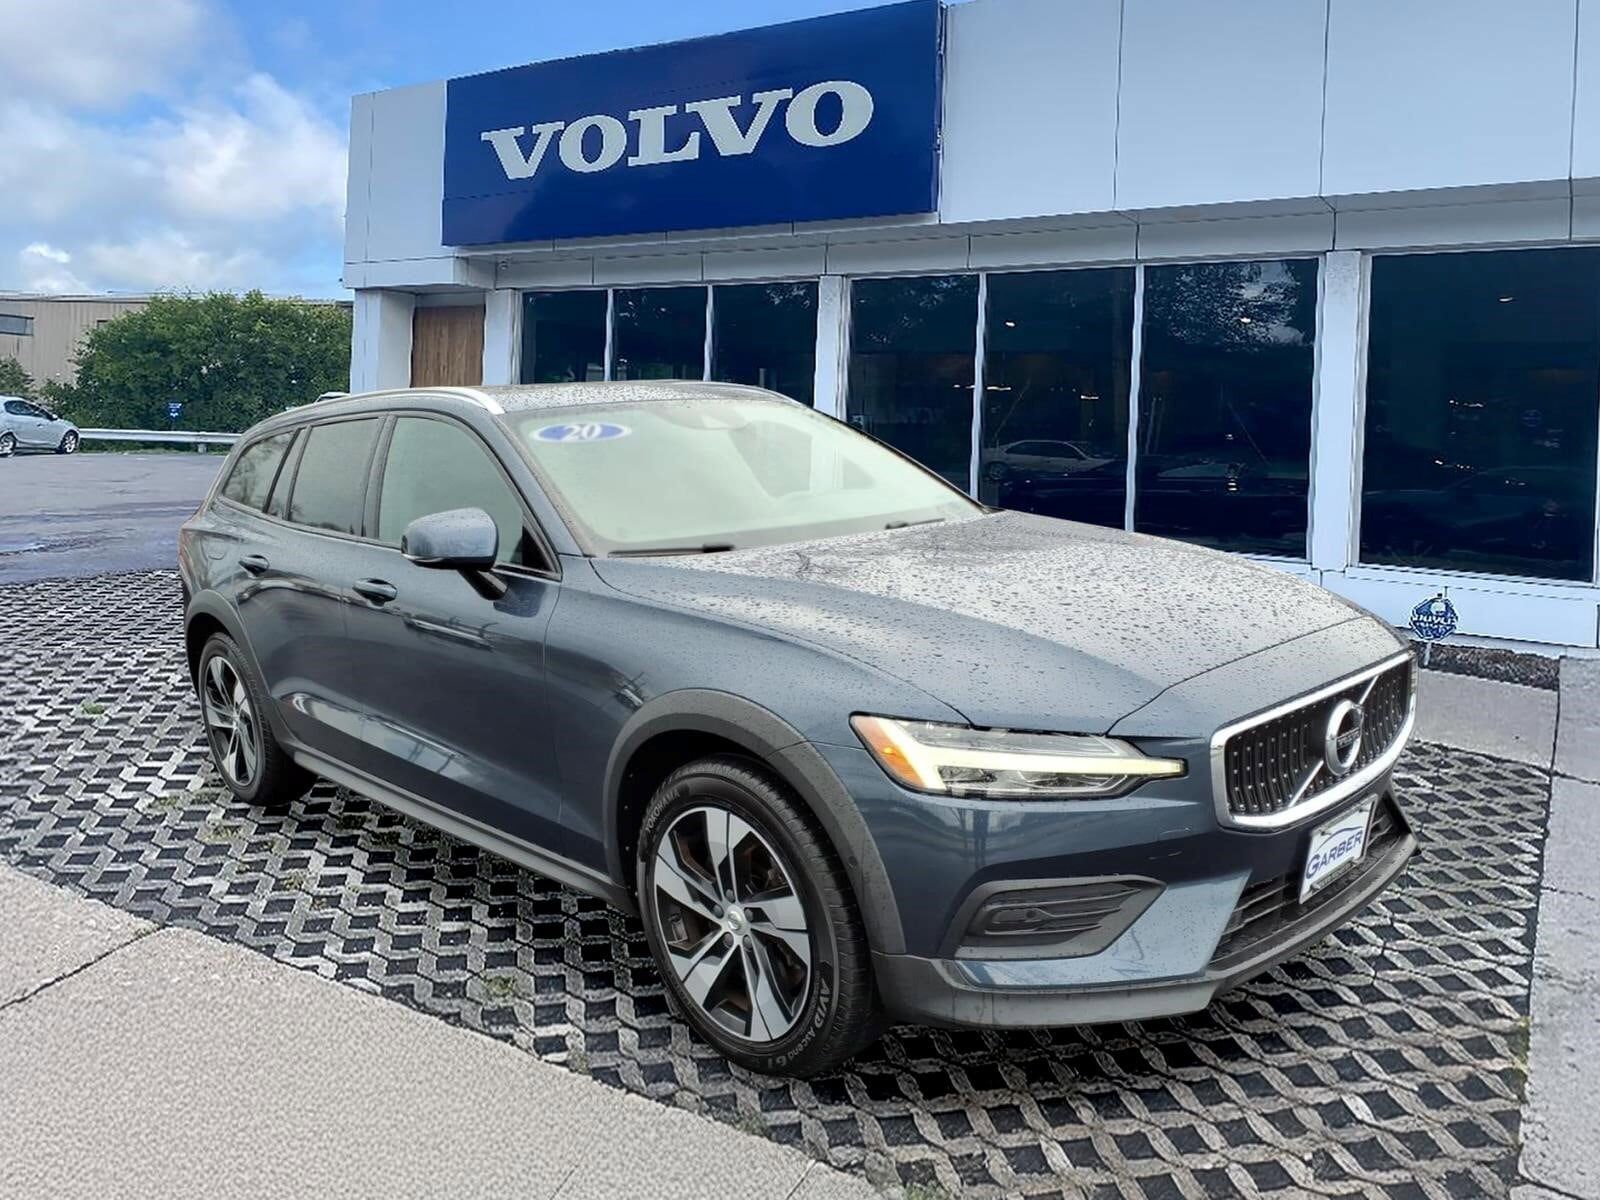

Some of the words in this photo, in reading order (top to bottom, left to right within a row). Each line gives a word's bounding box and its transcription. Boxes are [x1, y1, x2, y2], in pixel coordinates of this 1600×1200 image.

[481, 80, 874, 180] VOLVO
[560, 423, 603, 441] 20
[1306, 829, 1363, 879] GARBER
